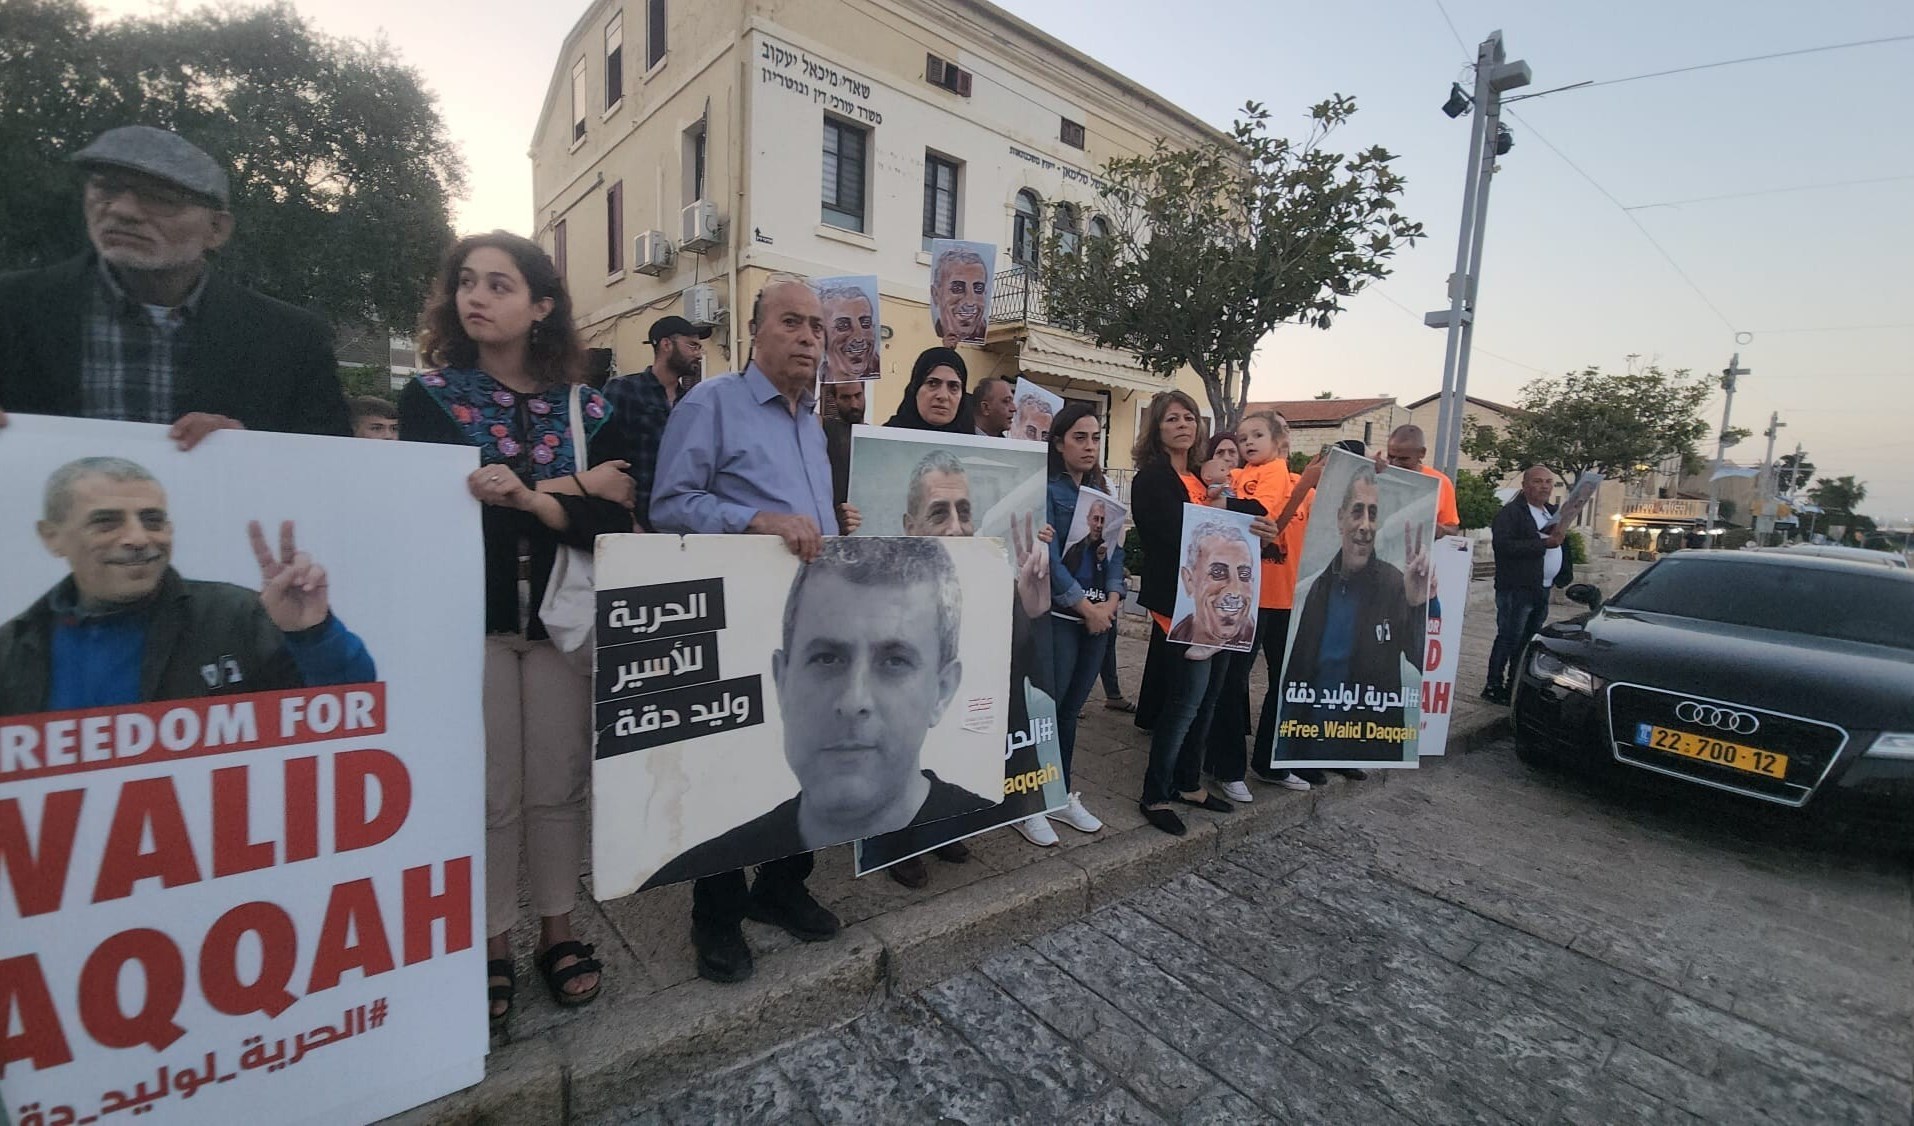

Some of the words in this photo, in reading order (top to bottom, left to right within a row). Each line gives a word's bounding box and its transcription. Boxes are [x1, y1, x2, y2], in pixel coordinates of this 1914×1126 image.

[762, 41, 797, 68] יעקוב
[801, 53, 838, 87] מיכאל
[762, 67, 809, 96] ונוטריון
[813, 88, 827, 104] דין
[841, 75, 871, 99] שאדי
[830, 94, 855, 115] עורכי
[857, 105, 883, 125] משרד
[608, 592, 707, 633] الحرية
[611, 641, 704, 693] للأسير
[615, 704, 681, 737] دقة
[690, 692, 750, 727] وليد
[0, 701, 259, 774] REEDOM
[279, 690, 376, 738] FOR
[1279, 719, 1417, 743] #Free_Walid_Daqqah
[0, 856, 473, 1080] AQQAH
